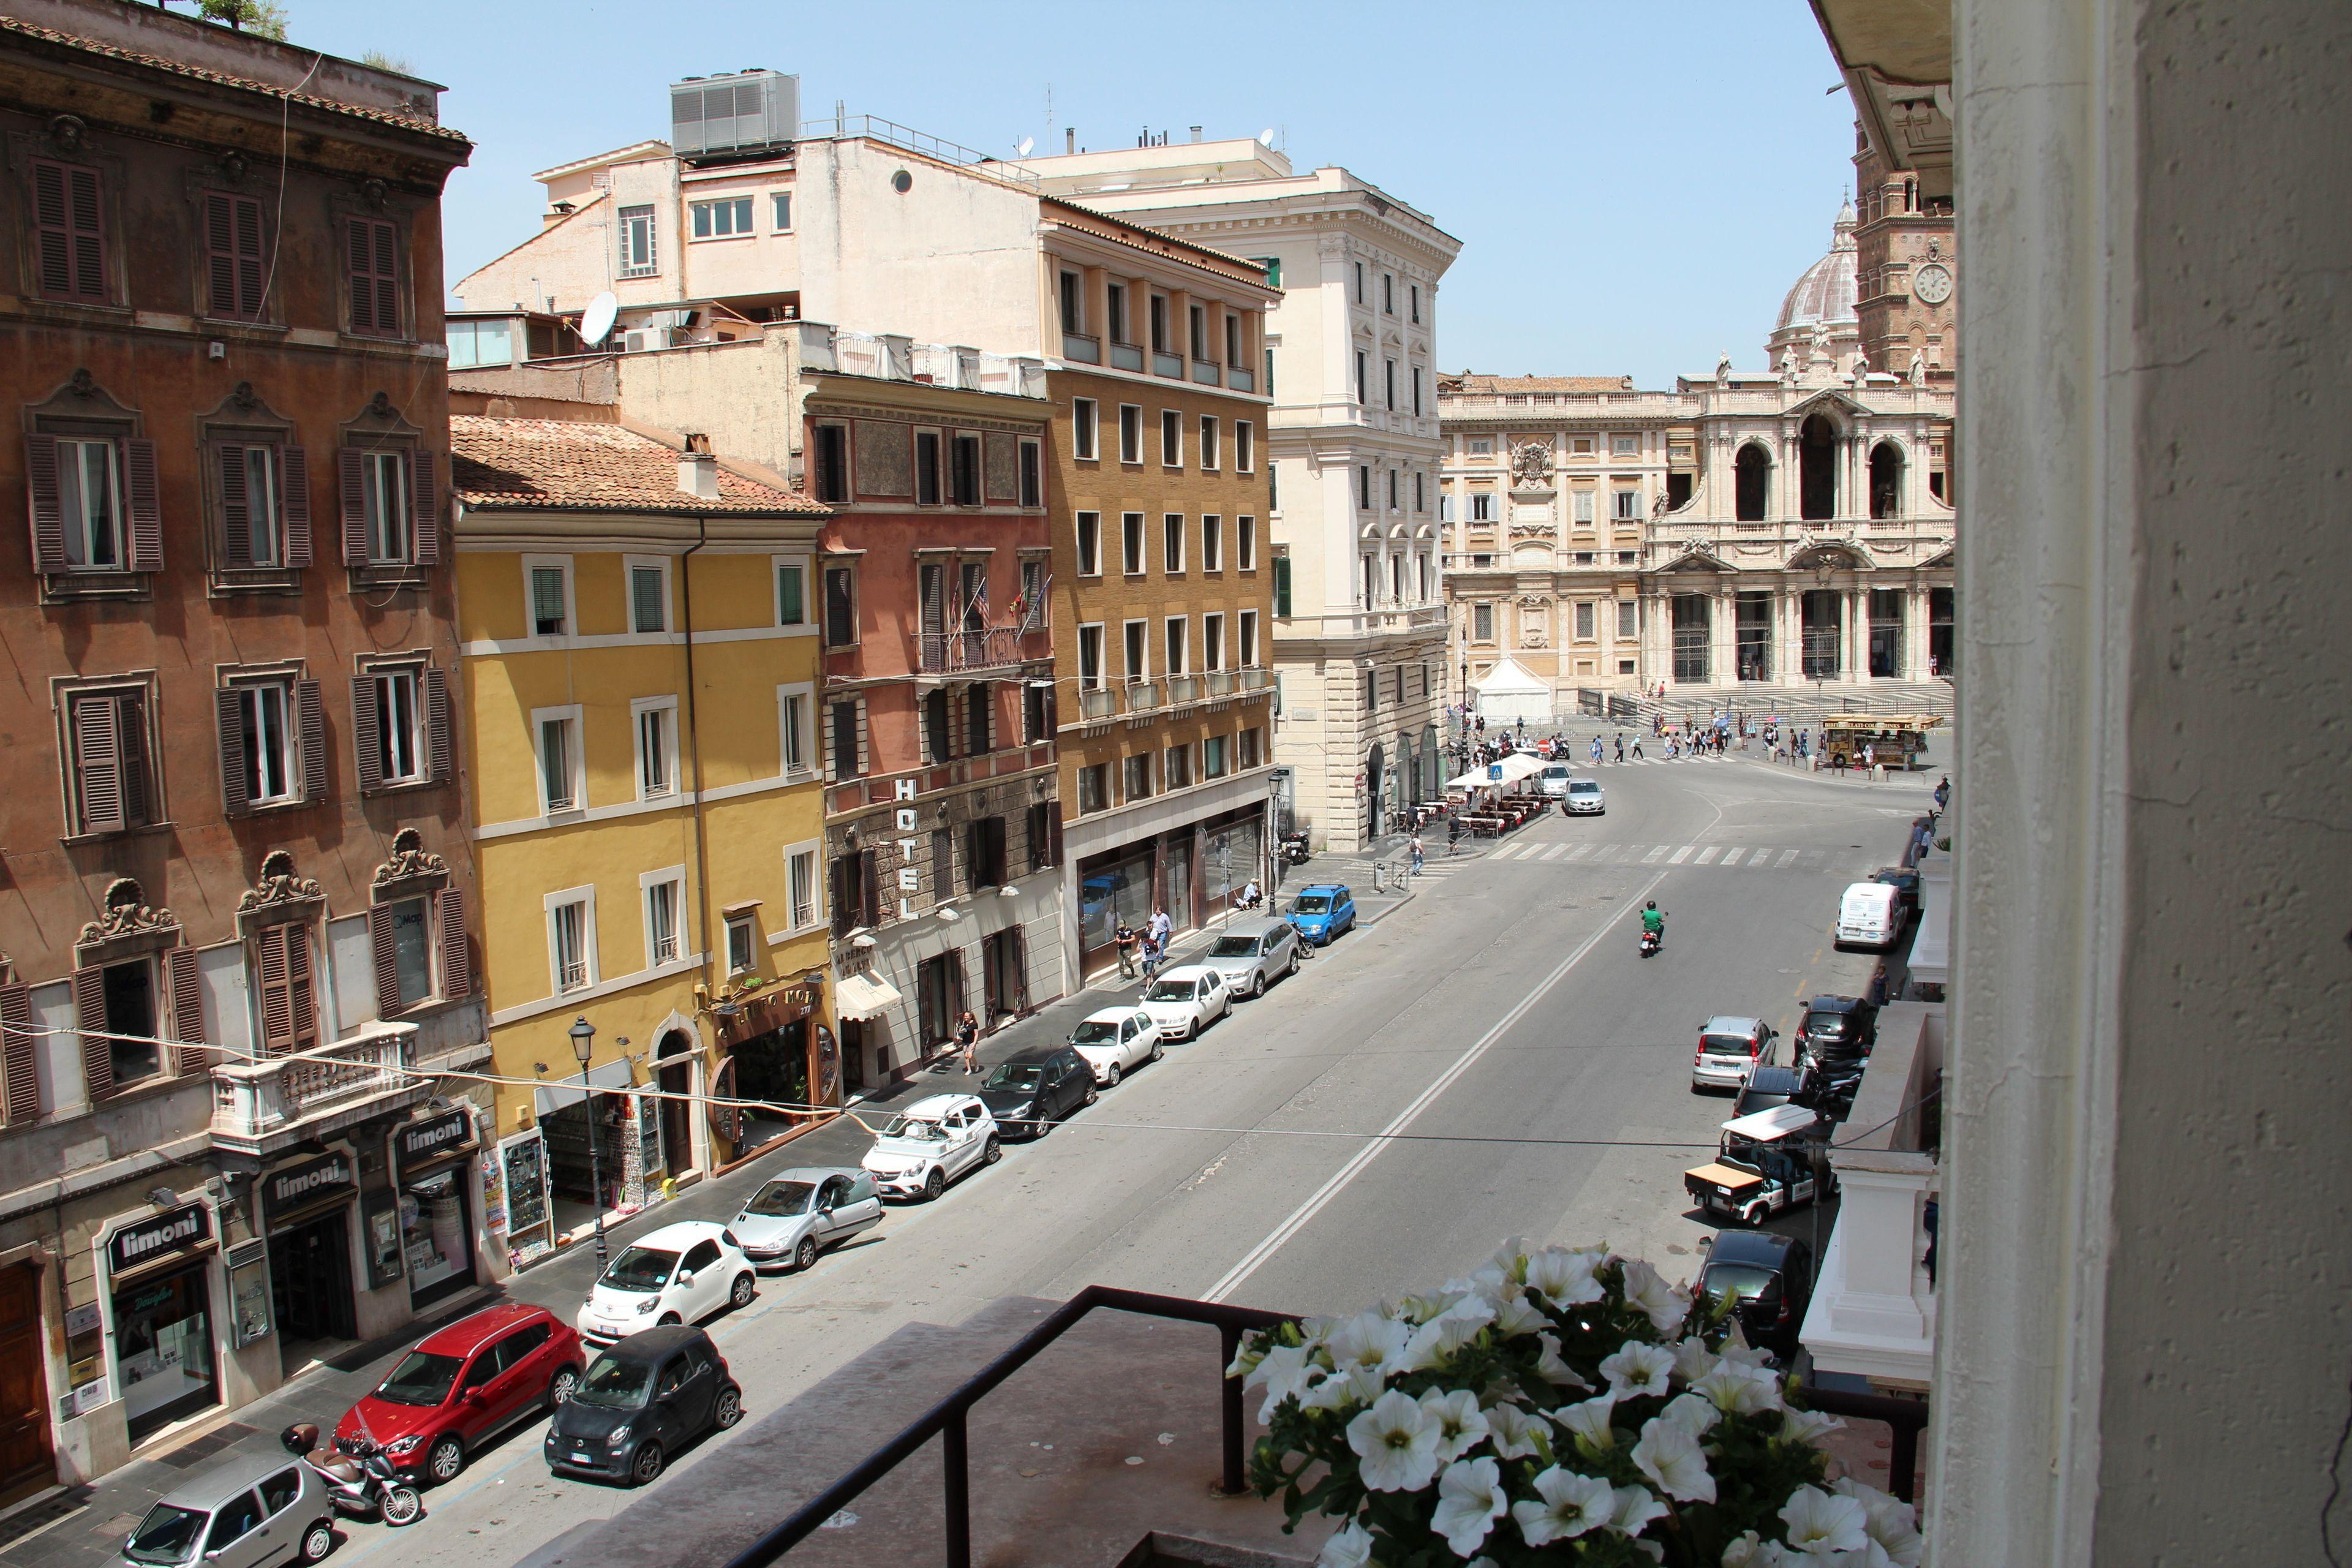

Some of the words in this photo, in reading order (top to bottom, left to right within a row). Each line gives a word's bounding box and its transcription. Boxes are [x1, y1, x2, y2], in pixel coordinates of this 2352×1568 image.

[895, 779, 920, 919] HOTEL
[800, 1005, 811, 1016] 277
[405, 1117, 462, 1153] limoni
[276, 1158, 339, 1200] limoni
[123, 1210, 198, 1258] limoni
